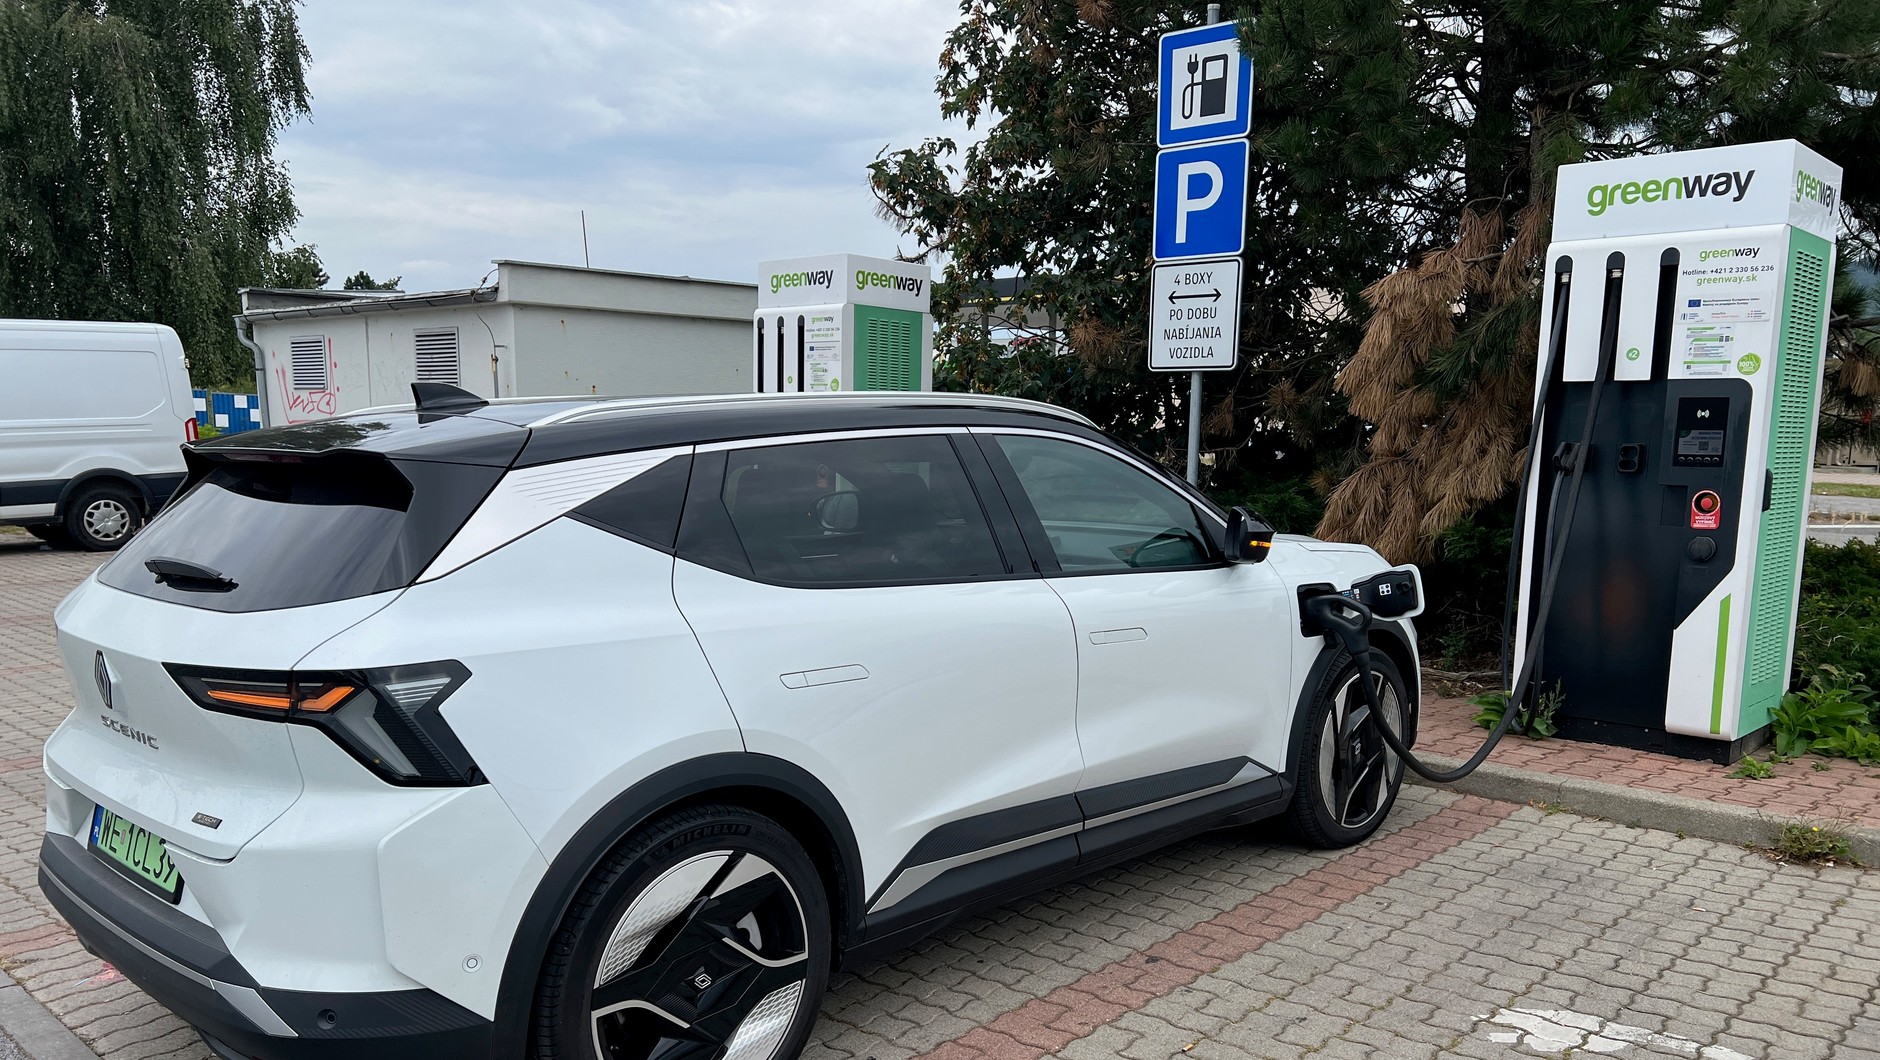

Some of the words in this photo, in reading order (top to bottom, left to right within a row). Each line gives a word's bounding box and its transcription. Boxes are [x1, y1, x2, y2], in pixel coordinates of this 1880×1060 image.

[1175, 160, 1224, 244] P
[1587, 169, 1755, 217] greenway
[1795, 169, 1837, 216] greenway
[1699, 247, 1760, 262] greenway
[770, 269, 833, 294] greenway
[855, 269, 923, 297] greenway
[1174, 274, 1181, 286] 4
[1184, 272, 1213, 285] BOXY
[1682, 268, 1708, 276] Hotline:
[1696, 274, 1758, 286] greenway.sk
[1169, 308, 1183, 321] PO
[1187, 306, 1217, 320] DOBU
[1163, 324, 1222, 341] NABÍJANIA
[1169, 346, 1214, 359] VOZIDLA
[101, 714, 160, 750] SCENIC
[101, 808, 124, 854] WE
[672, 824, 748, 849] MICHELIN
